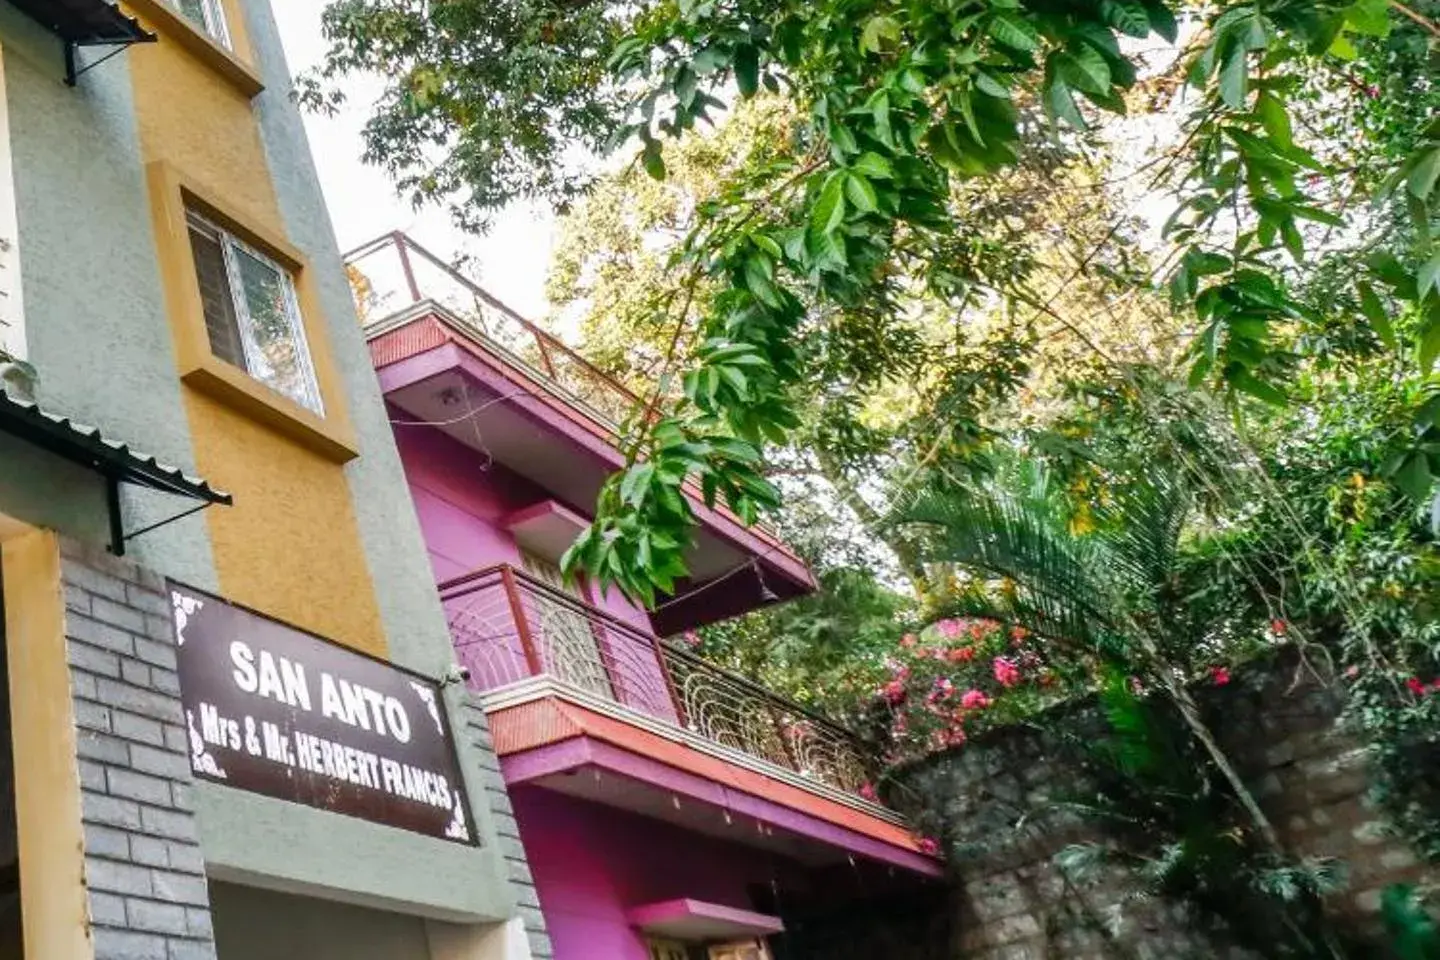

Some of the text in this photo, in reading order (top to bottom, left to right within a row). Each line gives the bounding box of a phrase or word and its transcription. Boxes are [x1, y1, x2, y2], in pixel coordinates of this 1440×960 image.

[229, 641, 411, 744] SAN ANTO
[200, 702, 243, 751] Mrs
[244, 716, 262, 756] &
[295, 731, 381, 789] HERBERT
[380, 757, 452, 811] FRANCIS
